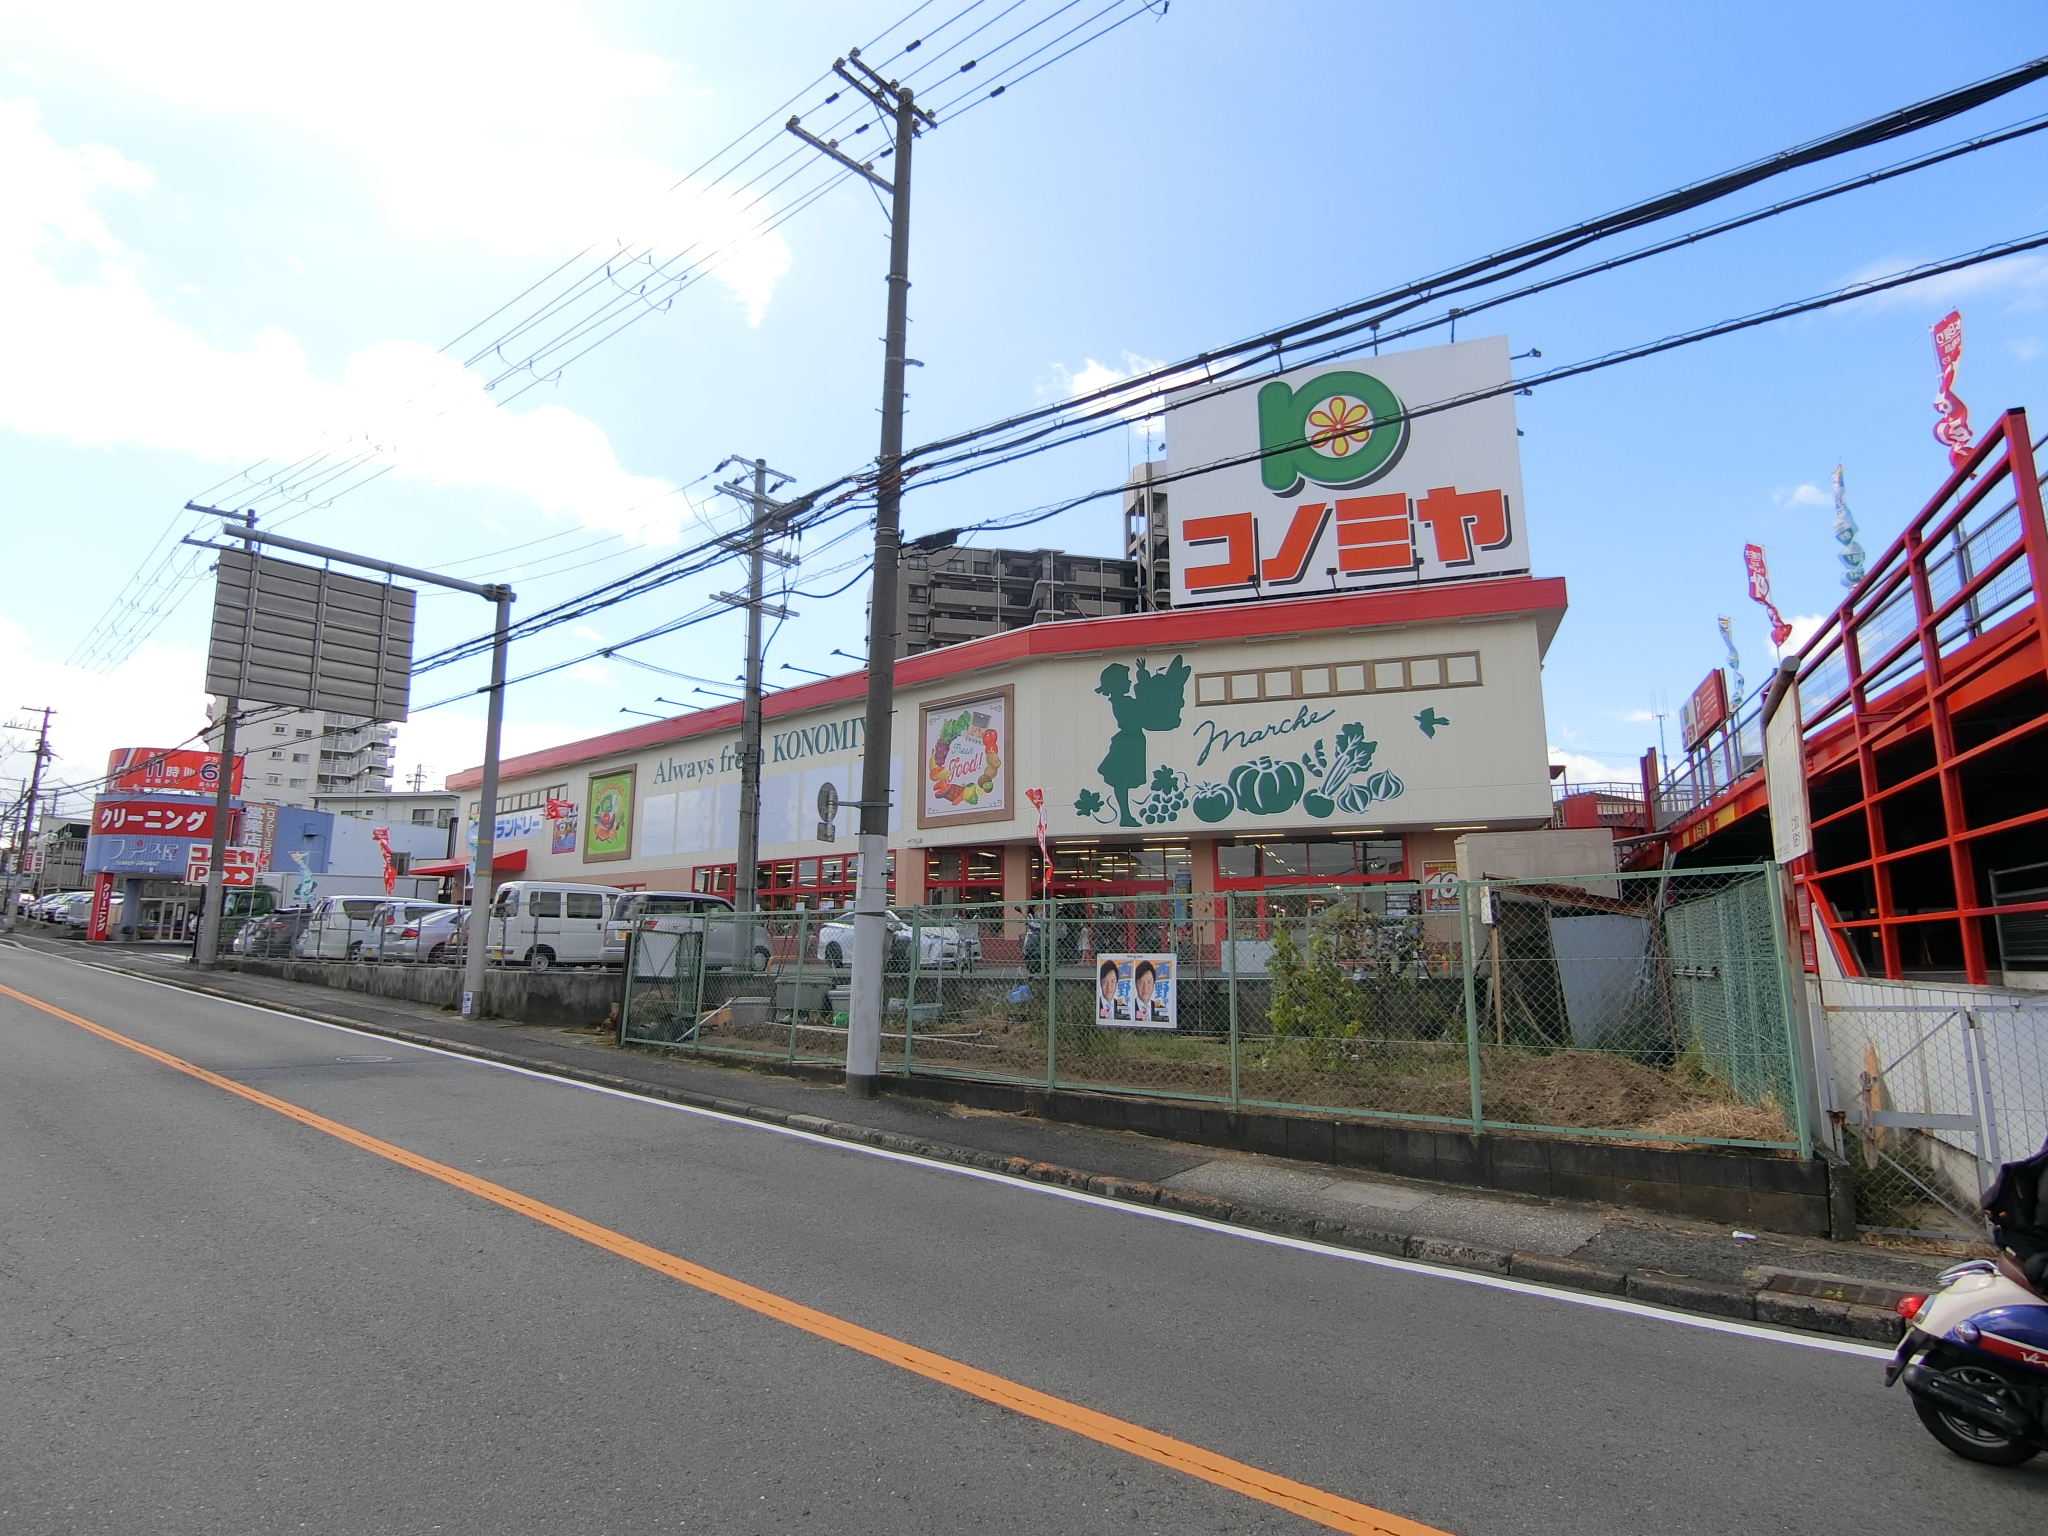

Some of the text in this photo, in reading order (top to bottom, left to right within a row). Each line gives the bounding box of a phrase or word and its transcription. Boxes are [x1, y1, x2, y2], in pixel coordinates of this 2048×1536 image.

[1183, 486, 1512, 594] コノミヤ
[951, 743, 974, 755] Fresh
[652, 757, 715, 785] Always
[946, 752, 984, 783] Food!
[101, 808, 207, 832] クリーニング
[191, 847, 255, 865] コミヤ
[194, 867, 208, 881] P
[97, 883, 111, 931] クリーニング
